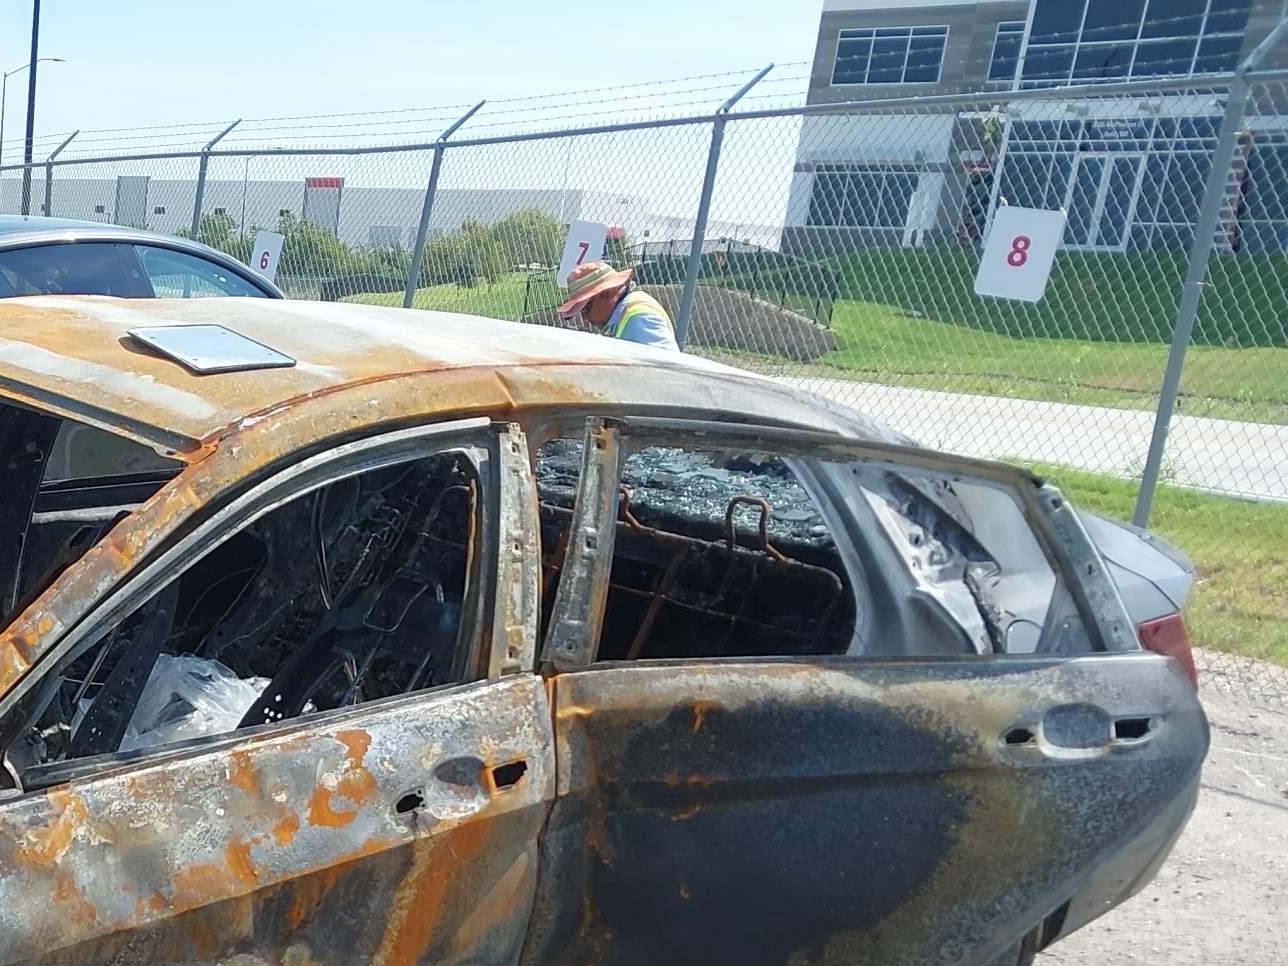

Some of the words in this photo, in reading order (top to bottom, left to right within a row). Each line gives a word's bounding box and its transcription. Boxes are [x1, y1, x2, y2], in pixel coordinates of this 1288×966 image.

[260, 251, 270, 269] 6
[575, 241, 589, 265] 7
[1007, 235, 1031, 267] 8
